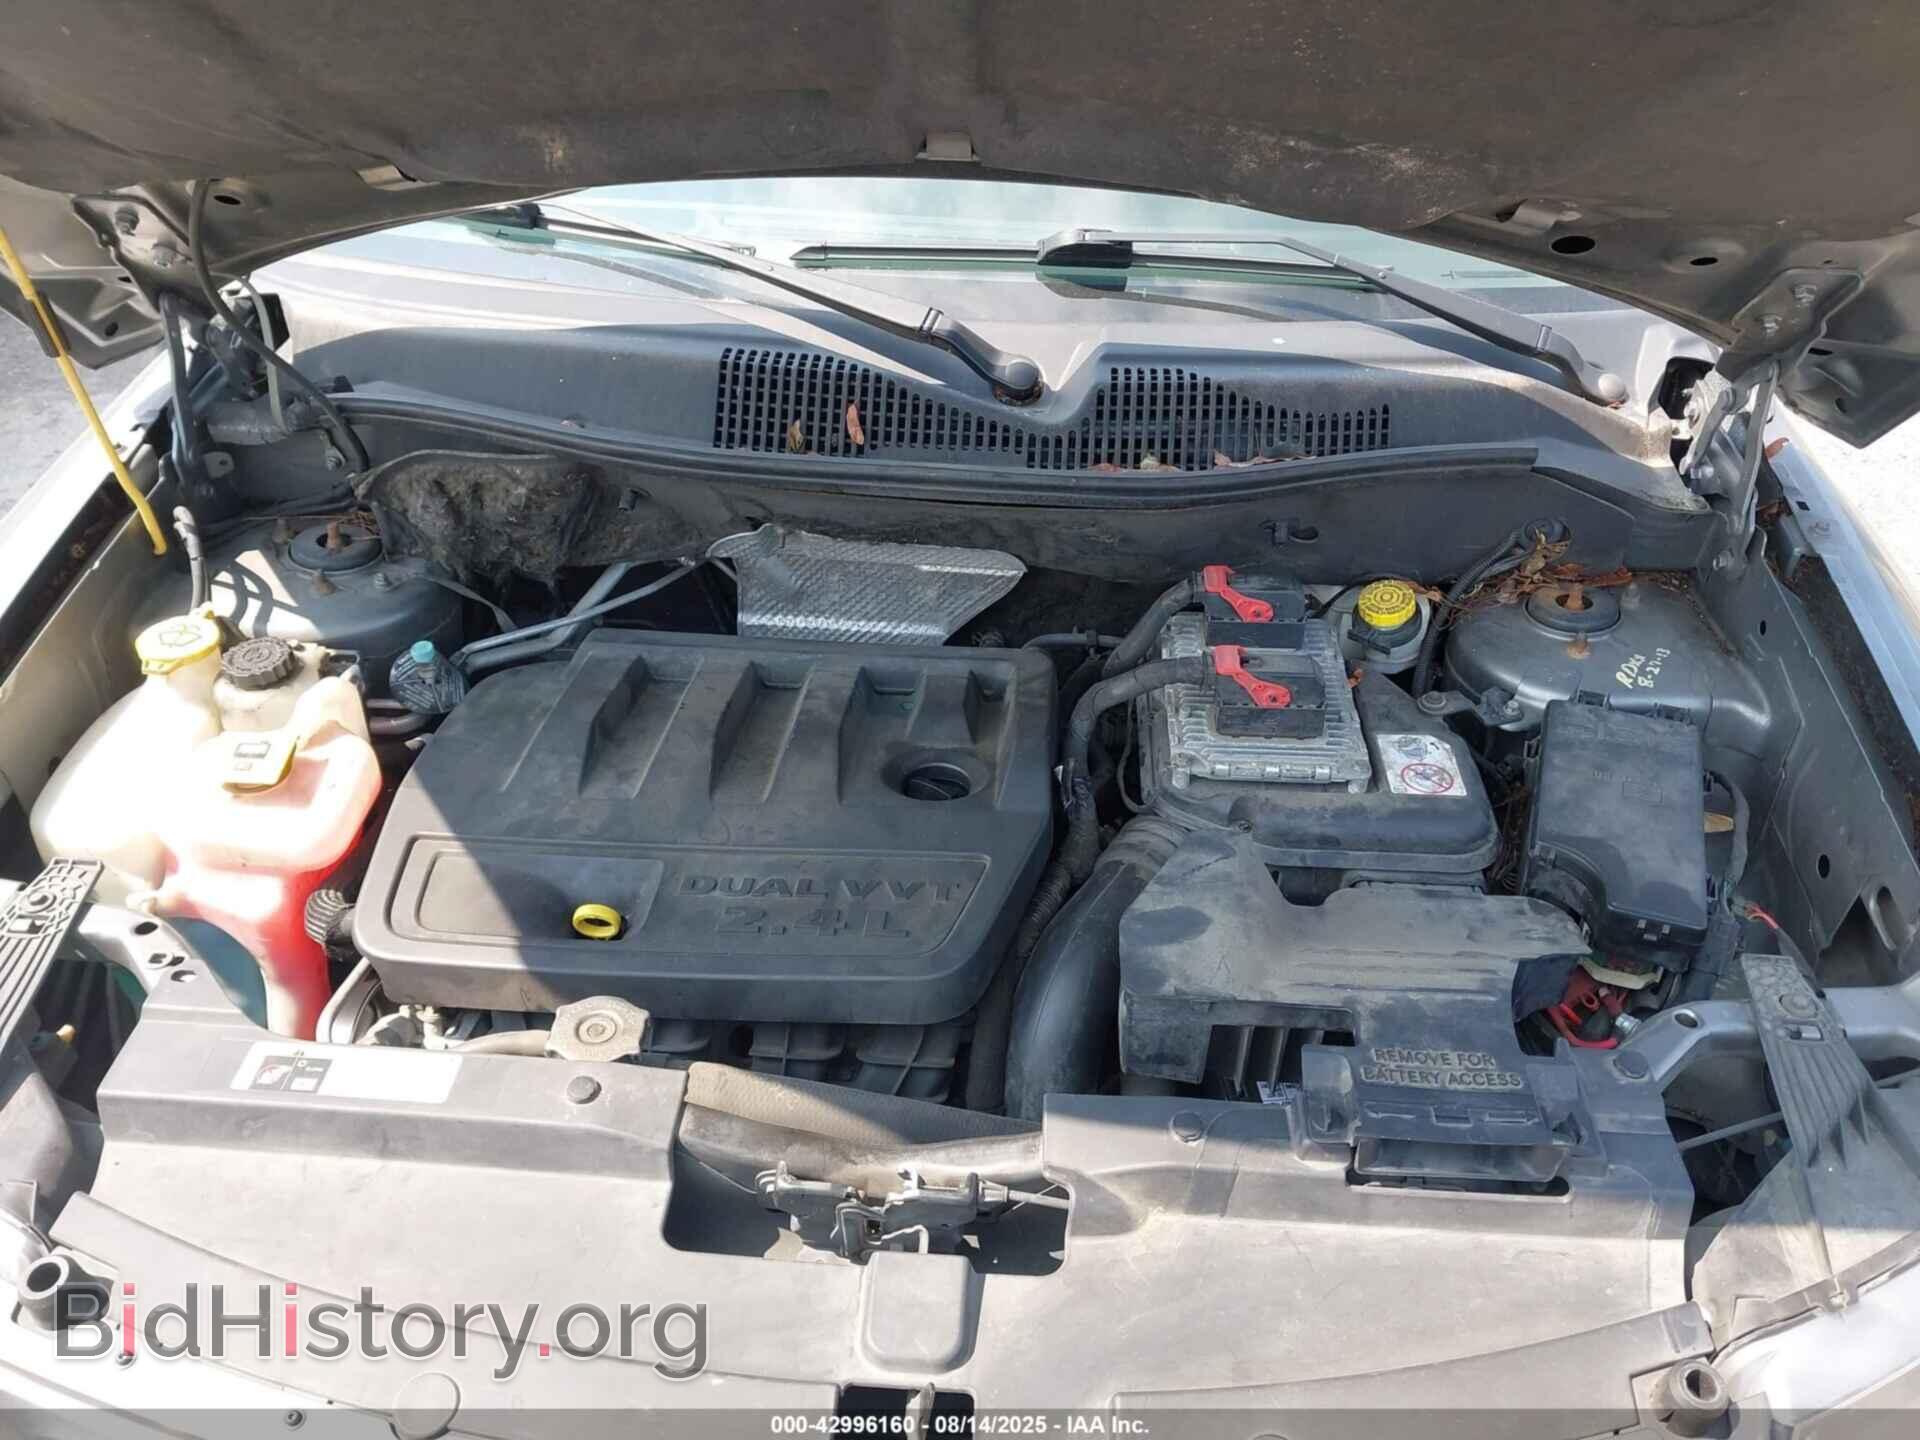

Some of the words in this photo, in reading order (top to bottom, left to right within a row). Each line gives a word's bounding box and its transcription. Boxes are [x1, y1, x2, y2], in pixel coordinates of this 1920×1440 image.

[681, 875, 829, 899] DUAL
[840, 878, 961, 902] VVT
[717, 905, 911, 938] 2.4L
[1373, 1048, 1450, 1066] REMOVE
[1457, 1054, 1495, 1069] FOR
[1361, 1066, 1440, 1085] BATTERY
[1447, 1072, 1522, 1089] ACCESS
